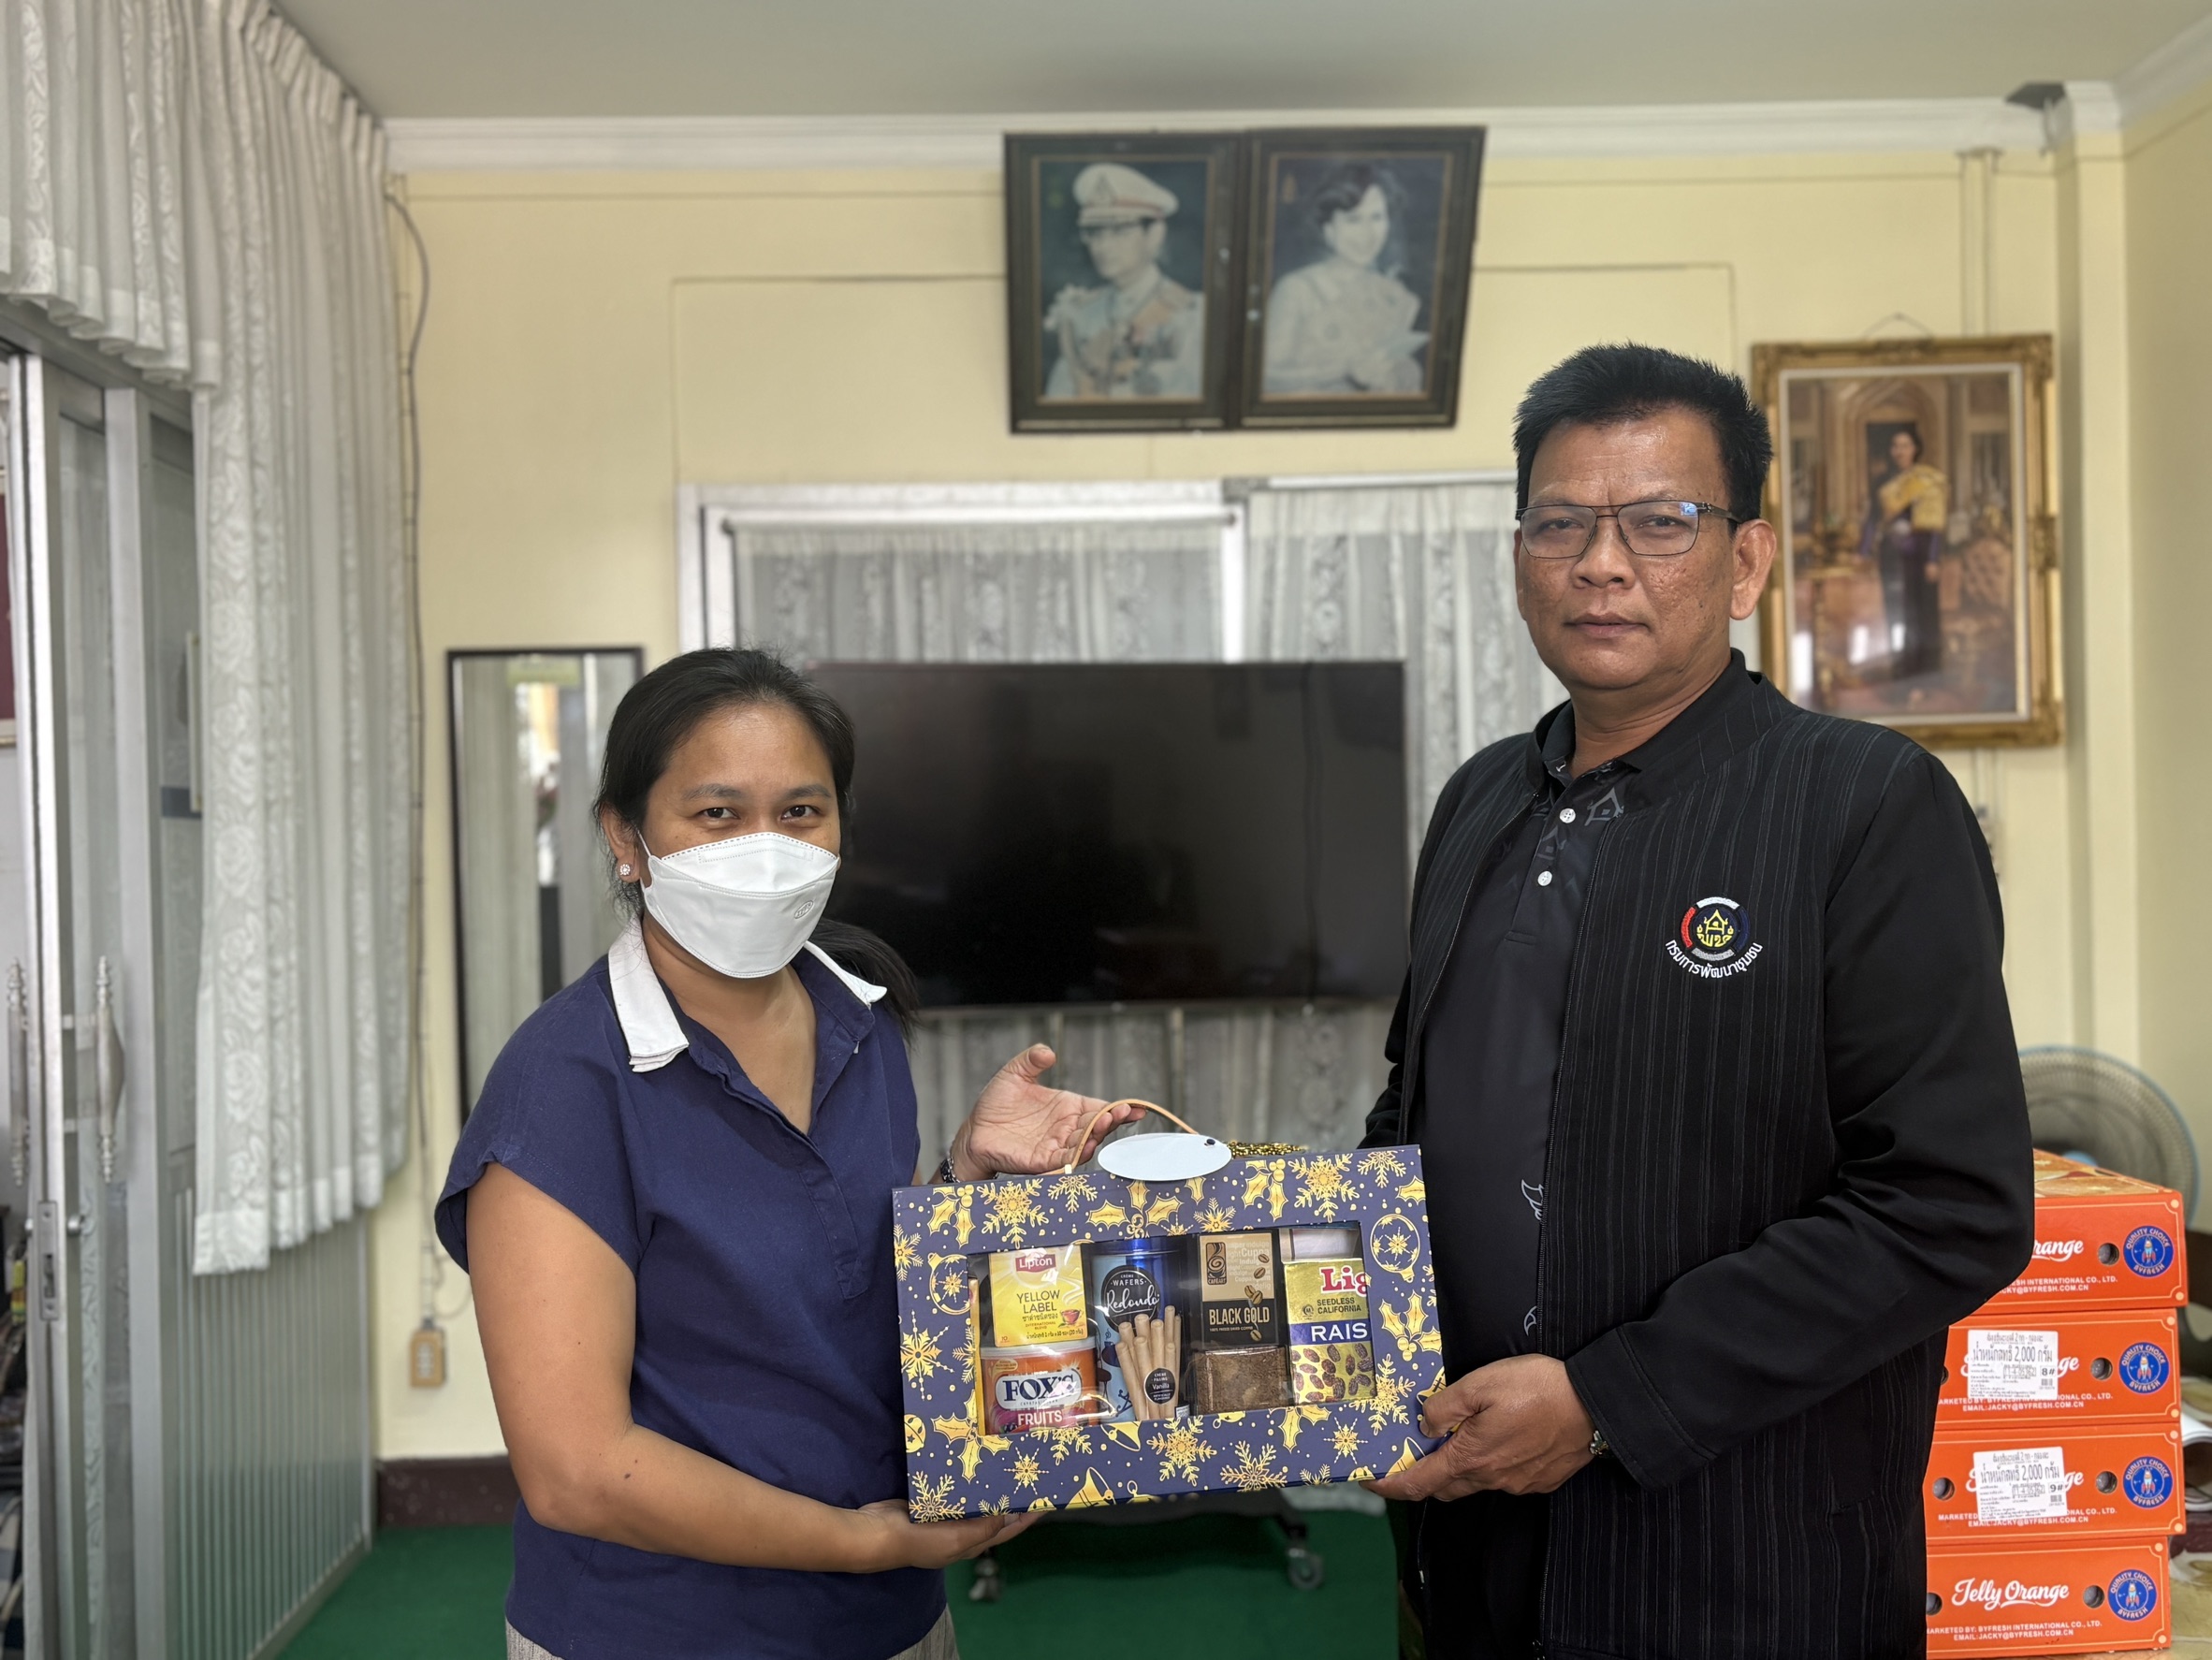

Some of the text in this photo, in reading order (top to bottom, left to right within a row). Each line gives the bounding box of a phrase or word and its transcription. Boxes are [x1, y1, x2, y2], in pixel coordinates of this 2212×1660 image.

[1666, 939, 1763, 978] กรมการพัฒนาชุมชน
[2126, 1228, 2171, 1250] QUALITY CHOICE
[1019, 1257, 1053, 1269] Lipton
[2133, 1263, 2165, 1274] BYFRESH
[1113, 1278, 1144, 1287] WAFERS
[2028, 1276, 2085, 1286] INTERNATIONAL
[1016, 1289, 1060, 1303] YELLOW
[1317, 1297, 1355, 1306] SEEDLESS
[1024, 1302, 1056, 1314] LABEL
[1317, 1304, 1361, 1315] CALIFORNIA
[1209, 1306, 1270, 1325] BLACK GOLD
[1311, 1322, 1368, 1342] RAIS
[1972, 1341, 2052, 1363] น้ำหนักสุทธิ 2,000 กรัม
[2121, 1345, 2166, 1366] QUALITY CHOICE
[2129, 1379, 2161, 1391] BYFRESH
[1962, 1401, 2084, 1412] EMAIL:JACKY@BYFRESH.COM.CN
[1017, 1410, 1063, 1426] FRUITS
[1981, 1463, 2019, 1484] น้ำหนักสุทธิ
[2022, 1464, 2043, 1482] 2,000
[2045, 1462, 2059, 1478] กรัม
[2125, 1459, 2170, 1480] QUALITY CHOICE
[2133, 1493, 2164, 1506] BYFRESH
[1938, 1513, 1978, 1522] MARKETED
[2110, 1572, 2154, 1594] QUALITY CHOICE
[1951, 1578, 2070, 1610] Jelly Orange
[2117, 1606, 2148, 1619] BYFRESH
[1978, 1624, 2012, 1633] BYFRESH
[2013, 1622, 2070, 1631] INTERNATIONAL
[1954, 1629, 2074, 1641] EMAIL:JACKY@BYFRESH.COM.CN
